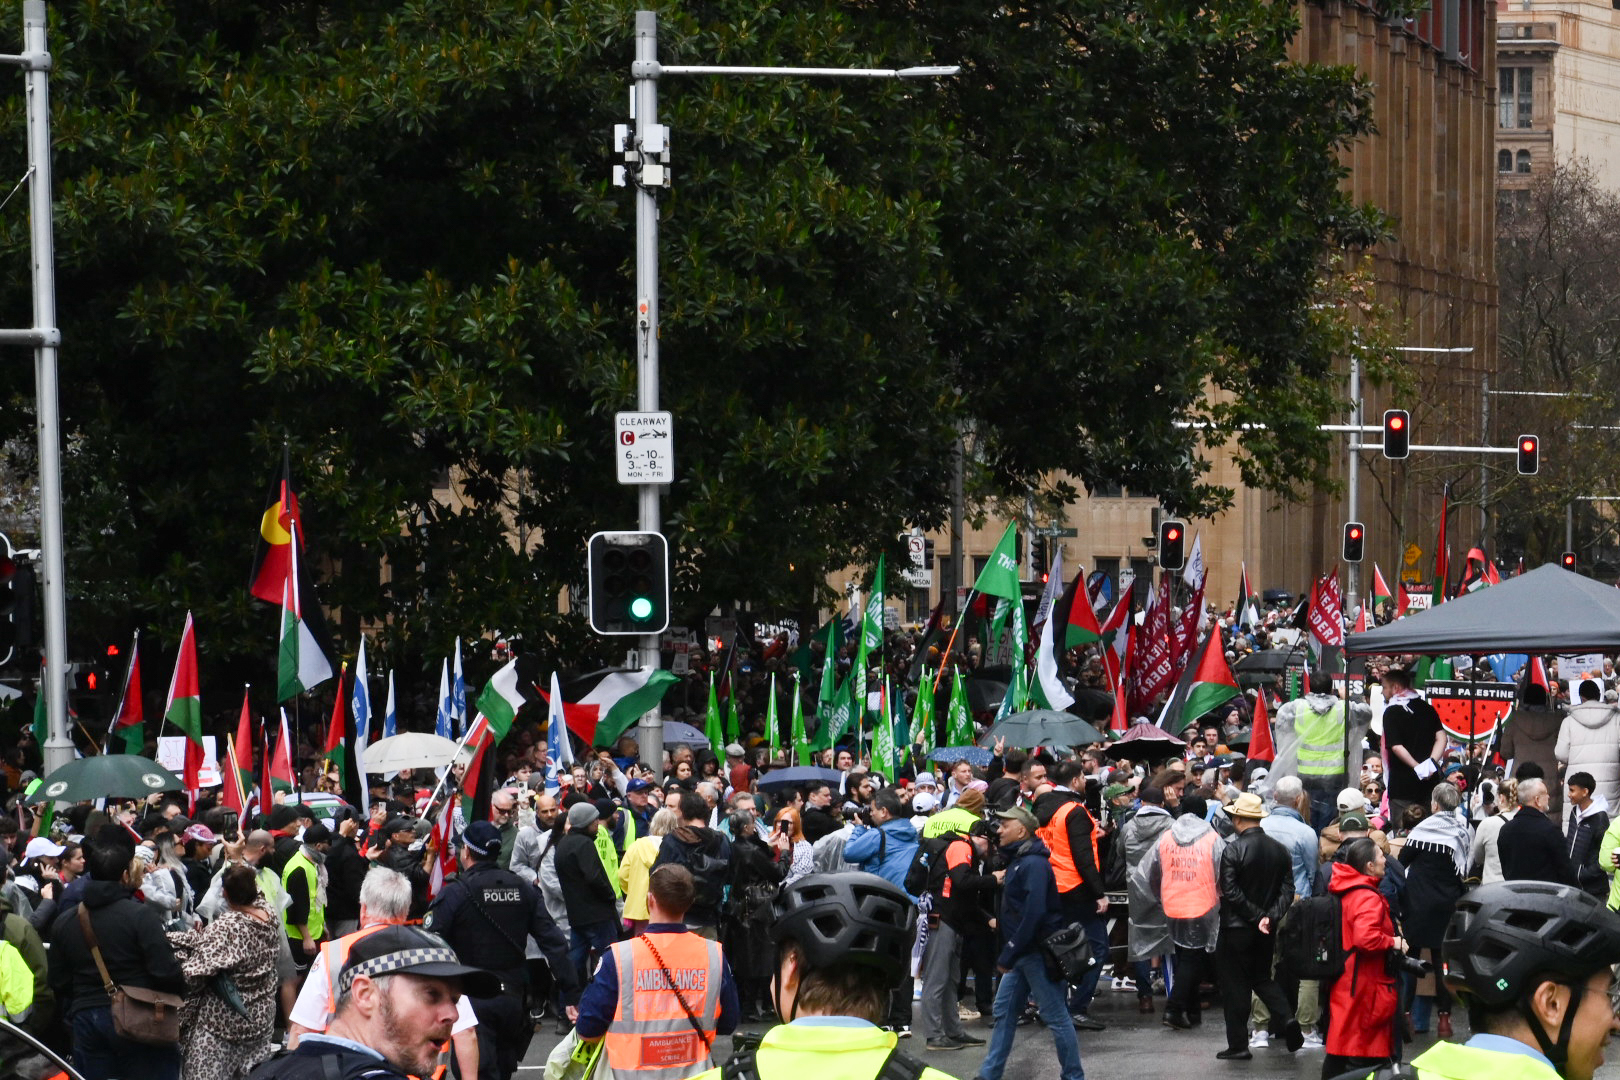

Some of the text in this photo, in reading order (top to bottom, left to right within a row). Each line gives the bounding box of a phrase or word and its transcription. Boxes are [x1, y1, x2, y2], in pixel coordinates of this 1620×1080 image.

[620, 418, 667, 426] CLEARWAY
[997, 552, 1016, 571] THE
[1425, 687, 1452, 695] FREE
[1458, 687, 1515, 698] PAESTINE
[930, 821, 962, 830] PALESTINE
[1170, 857, 1198, 868] ACTION
[483, 891, 521, 902] POLICE
[635, 968, 706, 991] AMBULANCE
[649, 1037, 692, 1047] AMBULANCE
